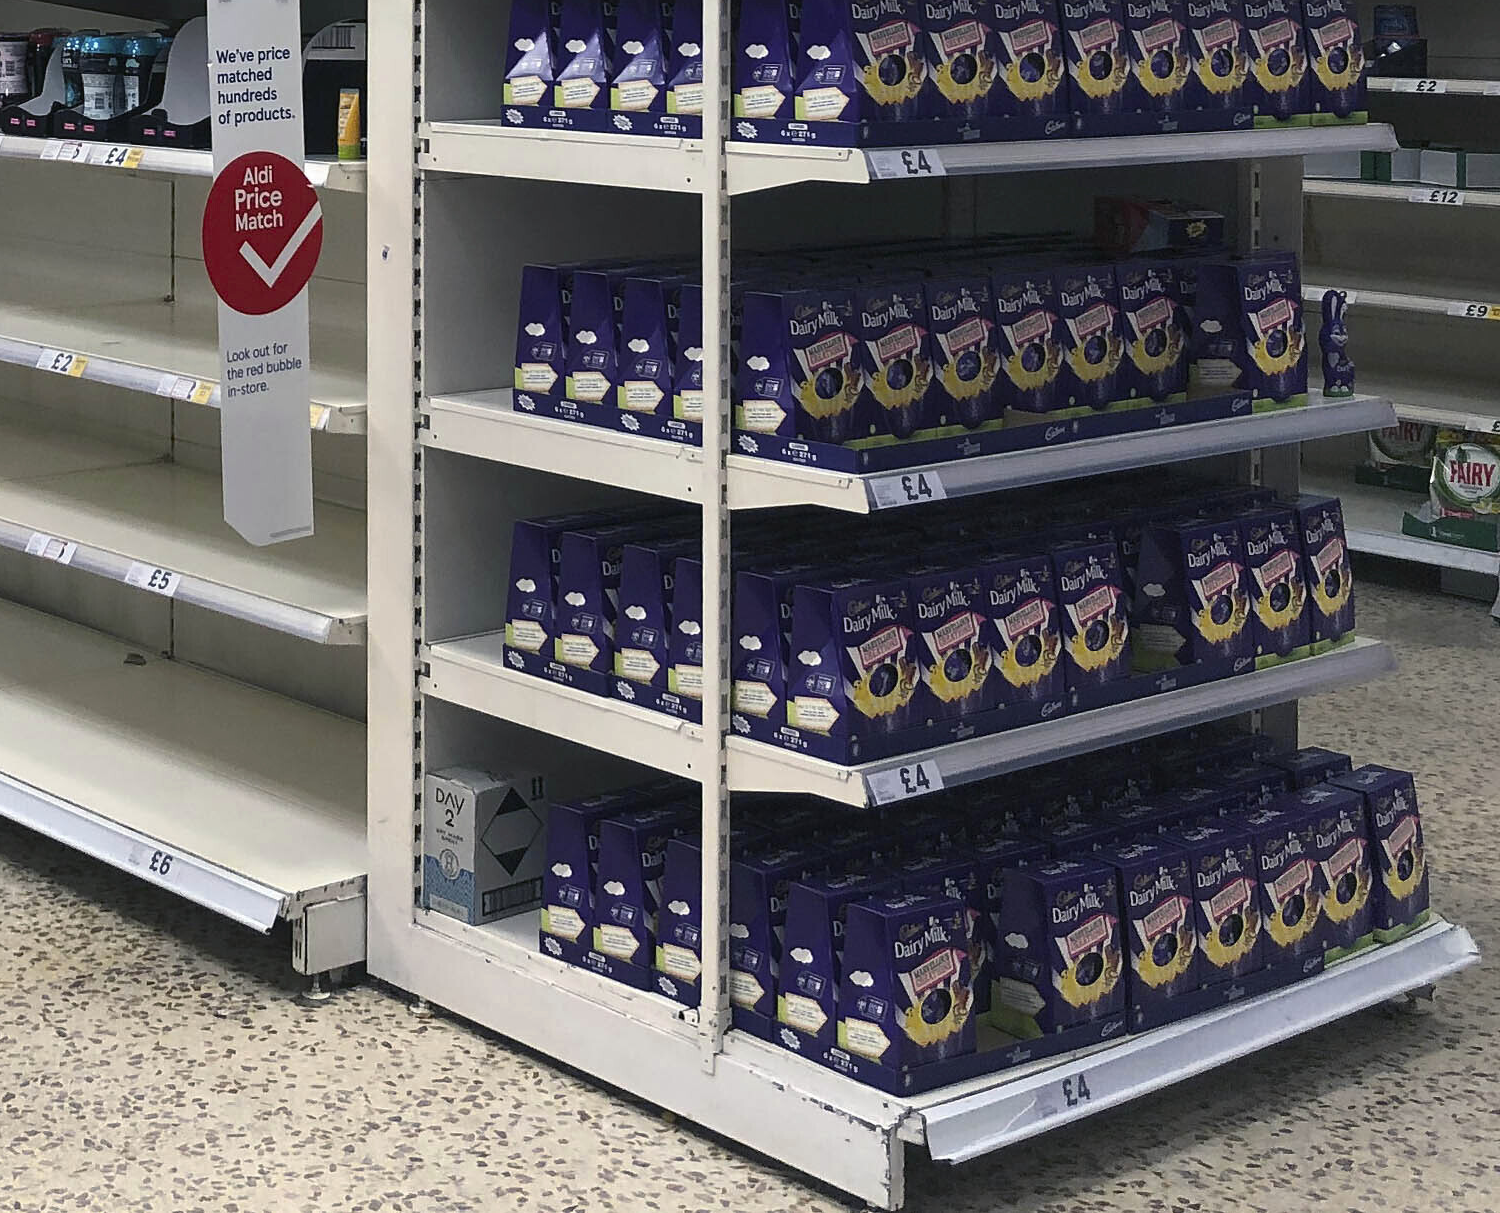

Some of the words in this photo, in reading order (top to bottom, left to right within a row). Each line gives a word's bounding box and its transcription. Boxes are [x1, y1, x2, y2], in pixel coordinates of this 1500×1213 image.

[852, 3, 880, 20] Dairy
[926, 4, 951, 20] Dairy
[217, 49, 254, 64] We've
[258, 47, 290, 65] price
[217, 67, 272, 84] matched
[1416, 80, 1437, 93] £2
[218, 87, 277, 104] hundreds
[218, 110, 231, 124] of
[234, 107, 296, 127] products.
[105, 148, 127, 166] £4
[901, 150, 932, 175] £4
[243, 166, 272, 186] Aldi
[235, 189, 282, 211] Price
[1429, 190, 1459, 204] £12
[235, 210, 283, 232] Match
[862, 311, 889, 327] Dairy
[889, 304, 913, 320] Milk
[1465, 304, 1488, 318] £9
[790, 319, 818, 335] Dairy
[818, 311, 843, 328] Milk
[51, 353, 73, 372] £2
[226, 347, 251, 363] Look
[253, 347, 270, 361] out
[272, 343, 288, 358] for
[227, 367, 243, 380] the
[246, 364, 263, 377] red
[266, 358, 302, 374] bubble
[227, 381, 269, 398] in-store.
[1450, 460, 1497, 487] FAIRY
[901, 475, 932, 501] £4
[146, 568, 171, 591] £5
[918, 601, 945, 619] Dairy
[945, 591, 971, 609] Milk
[843, 616, 872, 633] Dairy
[871, 604, 898, 624] Milk
[901, 763, 930, 793] £4
[435, 787, 465, 816] DAY
[445, 809, 454, 828] 2
[150, 849, 173, 877] £6
[1052, 904, 1081, 924] Dairy
[1080, 892, 1104, 912] Milk
[894, 938, 924, 959] Dairy
[924, 924, 951, 944] Milk
[1062, 1075, 1090, 1107] £4
